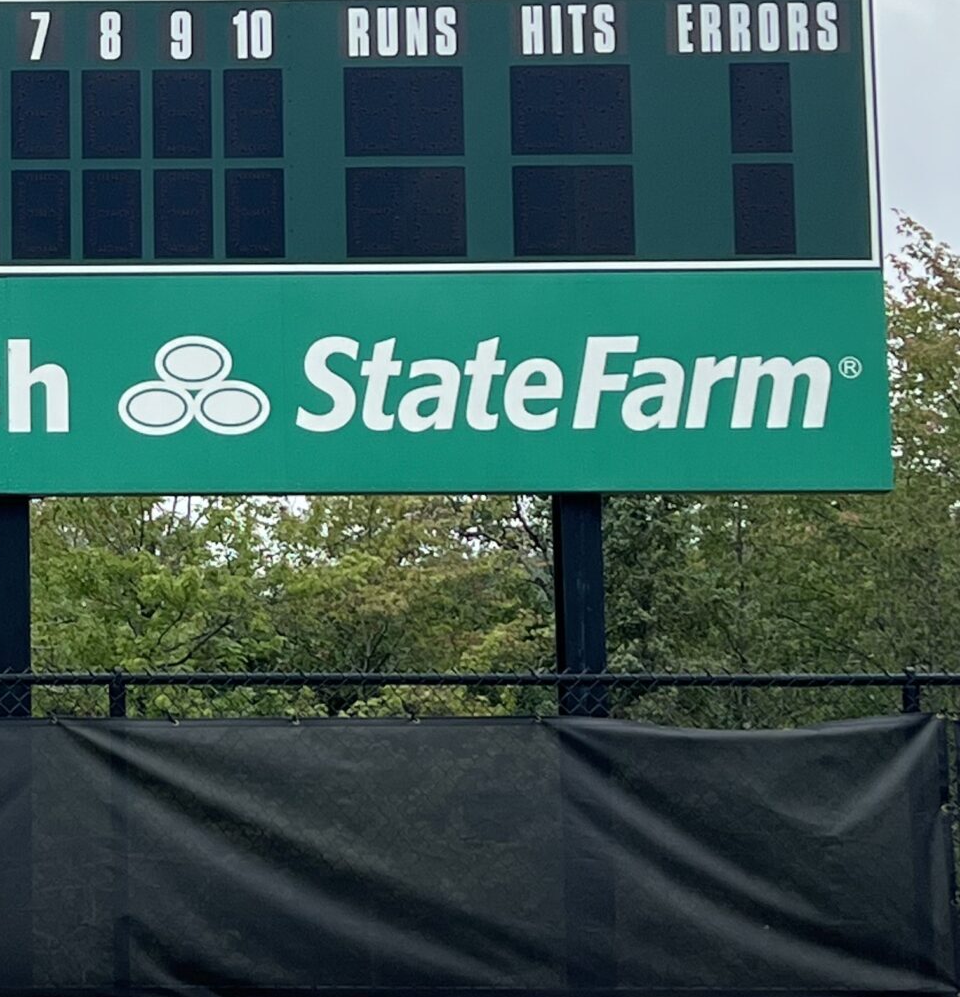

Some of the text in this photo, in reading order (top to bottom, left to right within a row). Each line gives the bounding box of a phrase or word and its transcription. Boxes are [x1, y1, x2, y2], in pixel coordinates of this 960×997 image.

[30, 11, 50, 61] 7
[100, 11, 121, 60] 8
[170, 10, 192, 60] 9
[232, 9, 272, 59] 10
[347, 6, 457, 57] RUNS
[521, 4, 616, 55] HITS
[677, 1, 838, 53] ERRORS
